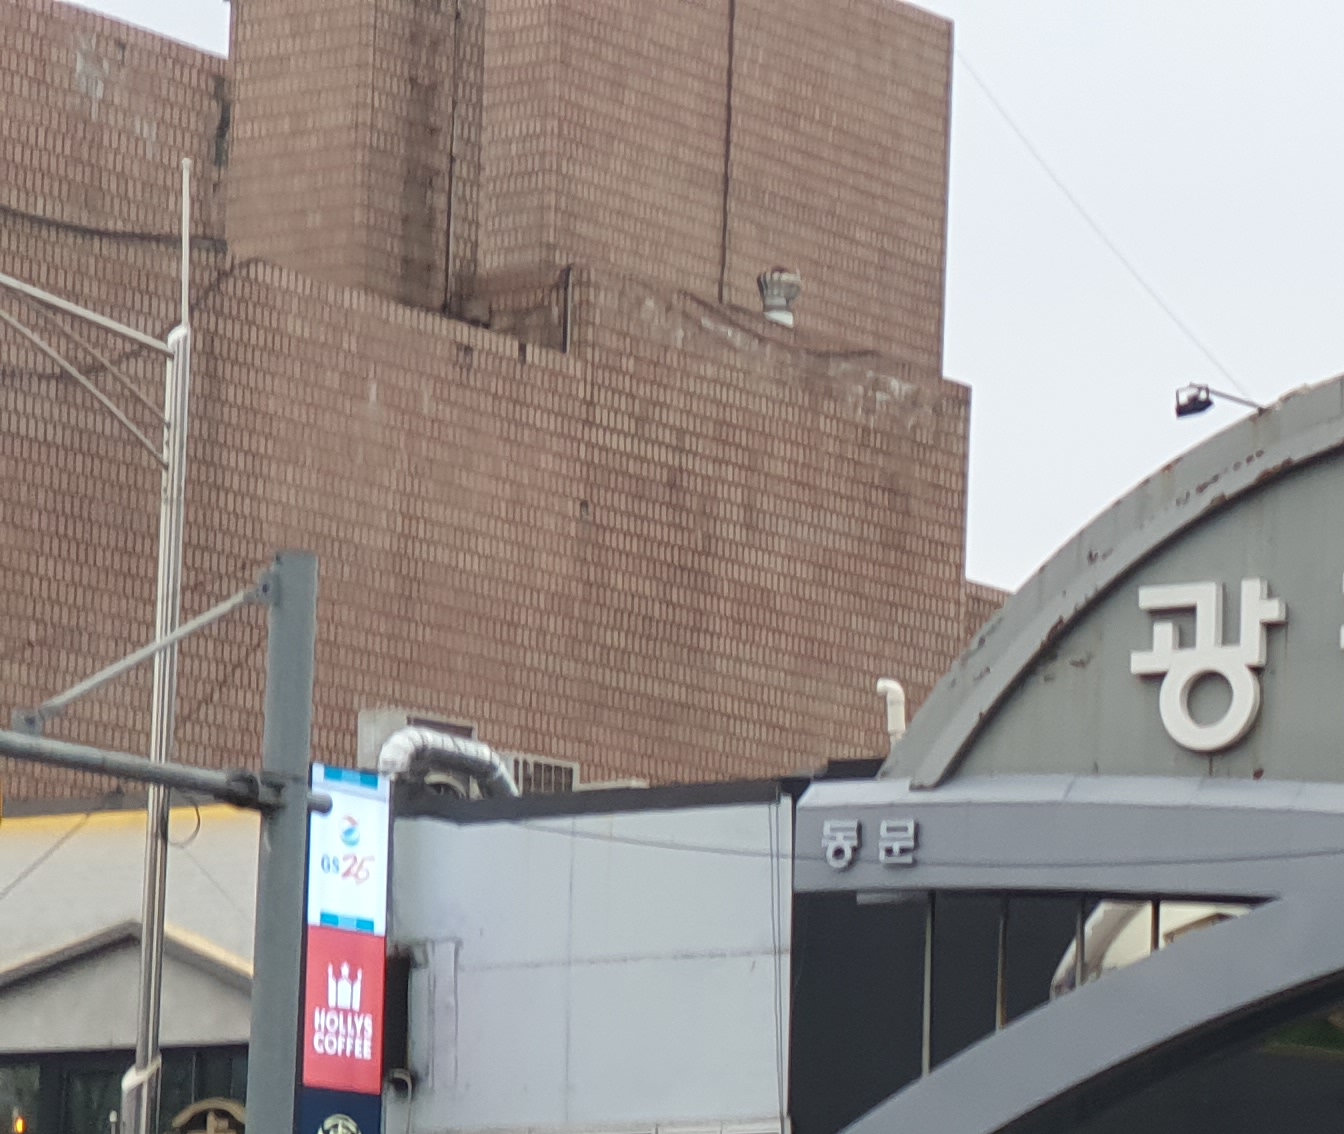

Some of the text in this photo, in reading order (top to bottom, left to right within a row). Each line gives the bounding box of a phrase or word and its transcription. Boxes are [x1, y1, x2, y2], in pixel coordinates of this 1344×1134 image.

[821, 818, 916, 868] 동문
[314, 1007, 373, 1038] HOLLYS
[313, 1031, 372, 1060] COFFEE
